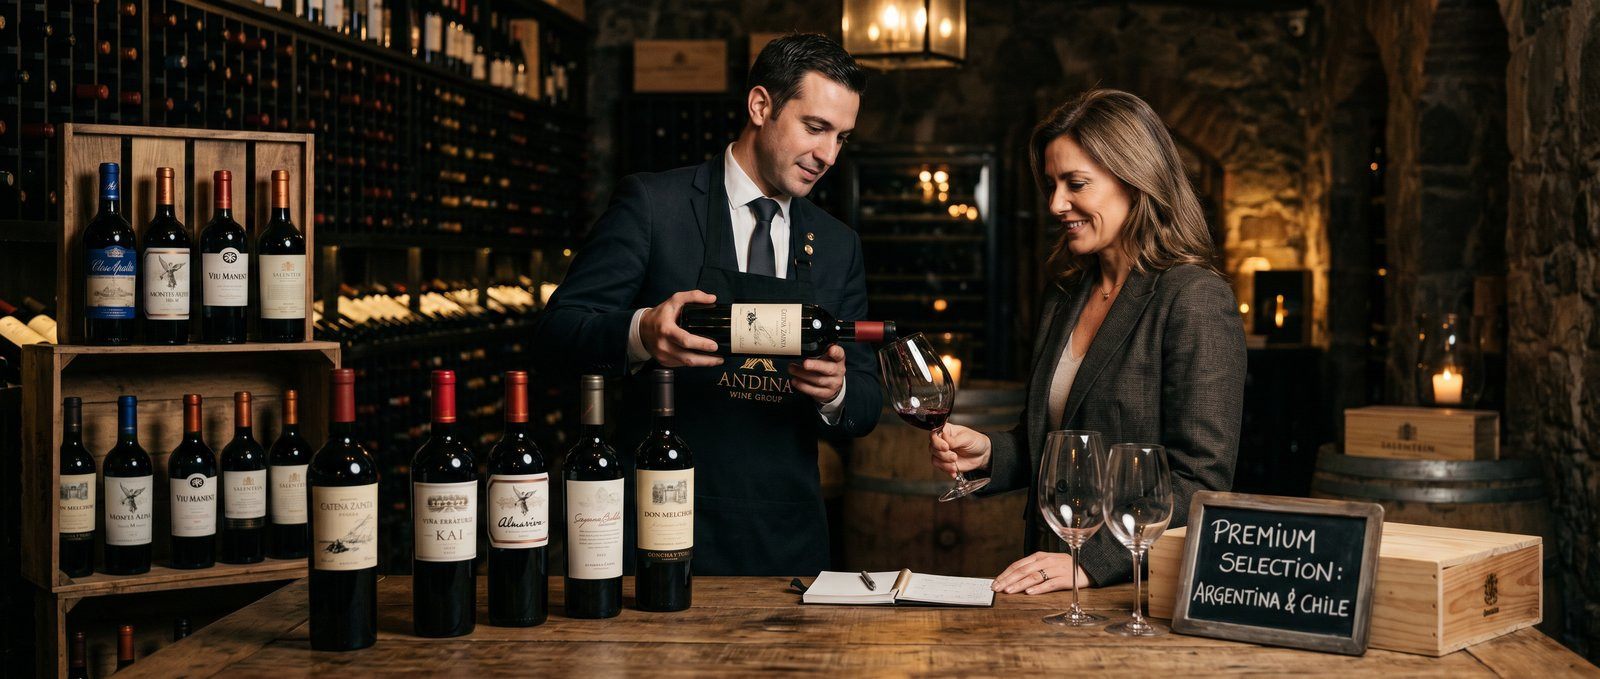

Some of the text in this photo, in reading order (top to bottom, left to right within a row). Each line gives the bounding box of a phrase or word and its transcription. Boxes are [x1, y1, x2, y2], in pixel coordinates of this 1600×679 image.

[208, 272, 221, 280] VIU
[717, 371, 794, 394] ANDINA
[729, 390, 783, 403] WINE GROUP
[1381, 440, 1435, 453] SALENTEIN
[175, 494, 189, 503] VIU
[320, 502, 349, 511] CATENA
[435, 529, 463, 541] KAI
[1284, 587, 1297, 614] &
